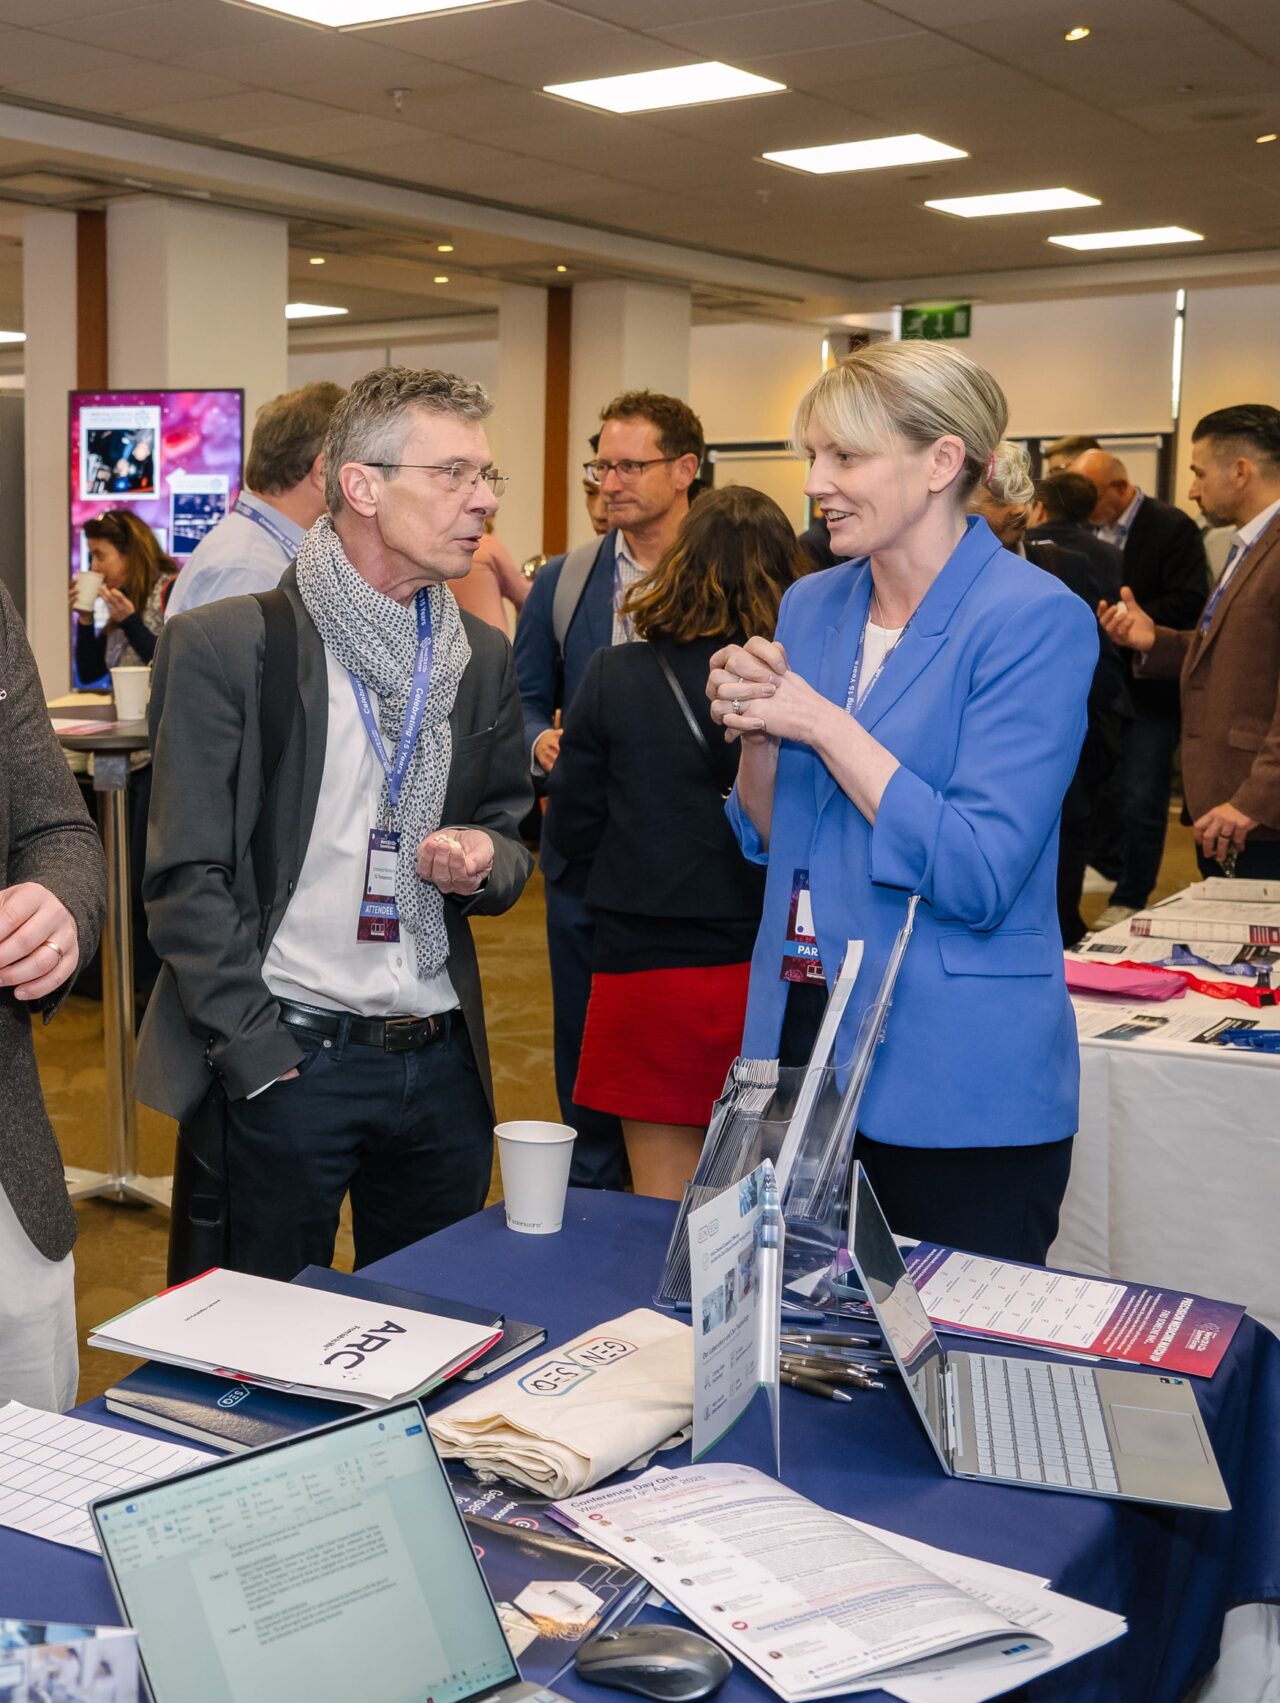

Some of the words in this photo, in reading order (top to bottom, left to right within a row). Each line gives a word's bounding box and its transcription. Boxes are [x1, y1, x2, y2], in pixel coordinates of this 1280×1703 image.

[849, 660, 859, 684] Years
[356, 679, 370, 714] Celebrat
[848, 685, 855, 695] 15
[405, 687, 424, 737] Celebrating
[402, 737, 412, 749] 15
[395, 750, 408, 775] Years
[365, 904, 395, 916] ATTENDEE
[1173, 1297, 1194, 1321] PRECISION
[1161, 1320, 1182, 1343] MEDICINE
[323, 1320, 408, 1370] ARC
[579, 1340, 628, 1364] GEN
[530, 1367, 579, 1391] SEQ
[221, 1390, 244, 1405] SEQ
[571, 1486, 633, 1508] Conference
[633, 1481, 656, 1491] Day
[655, 1474, 680, 1484] One
[577, 1494, 637, 1513] Wednesday
[680, 1475, 707, 1485] 2025
